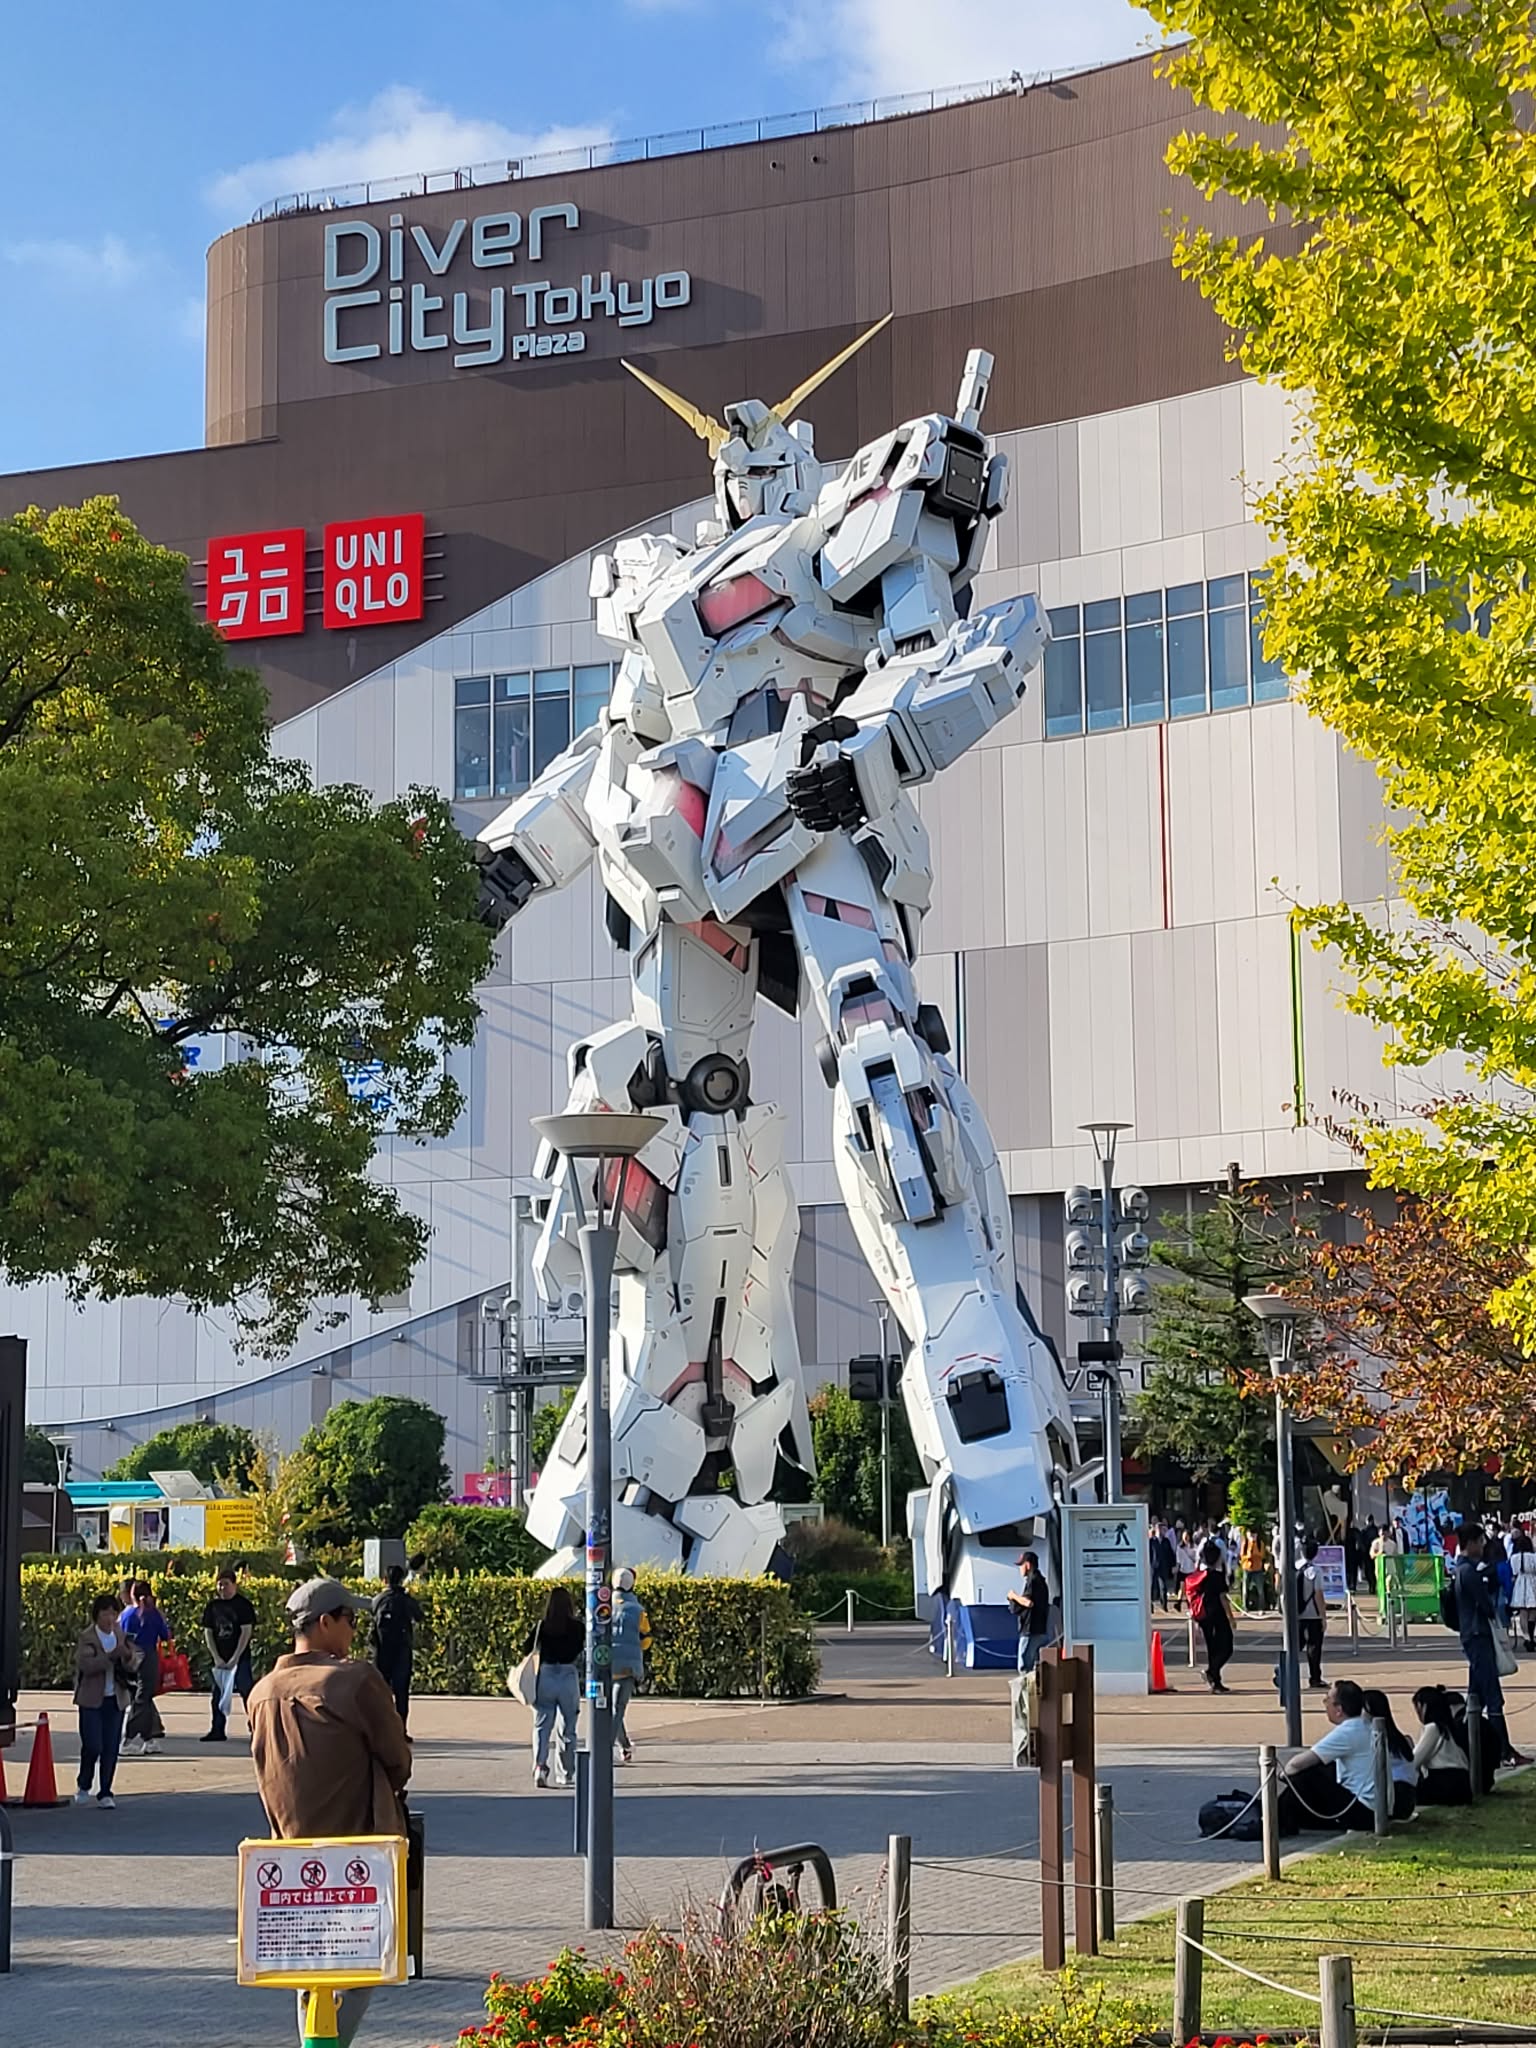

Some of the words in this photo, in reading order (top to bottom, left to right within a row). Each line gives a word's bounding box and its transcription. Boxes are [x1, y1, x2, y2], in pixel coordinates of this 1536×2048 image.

[324, 202, 580, 291] Diver
[323, 283, 505, 369] City
[512, 331, 586, 361] Plaza
[219, 543, 288, 584] ユニ
[334, 529, 403, 571] UNI
[217, 588, 289, 627] クロ
[334, 573, 410, 620] QLO
